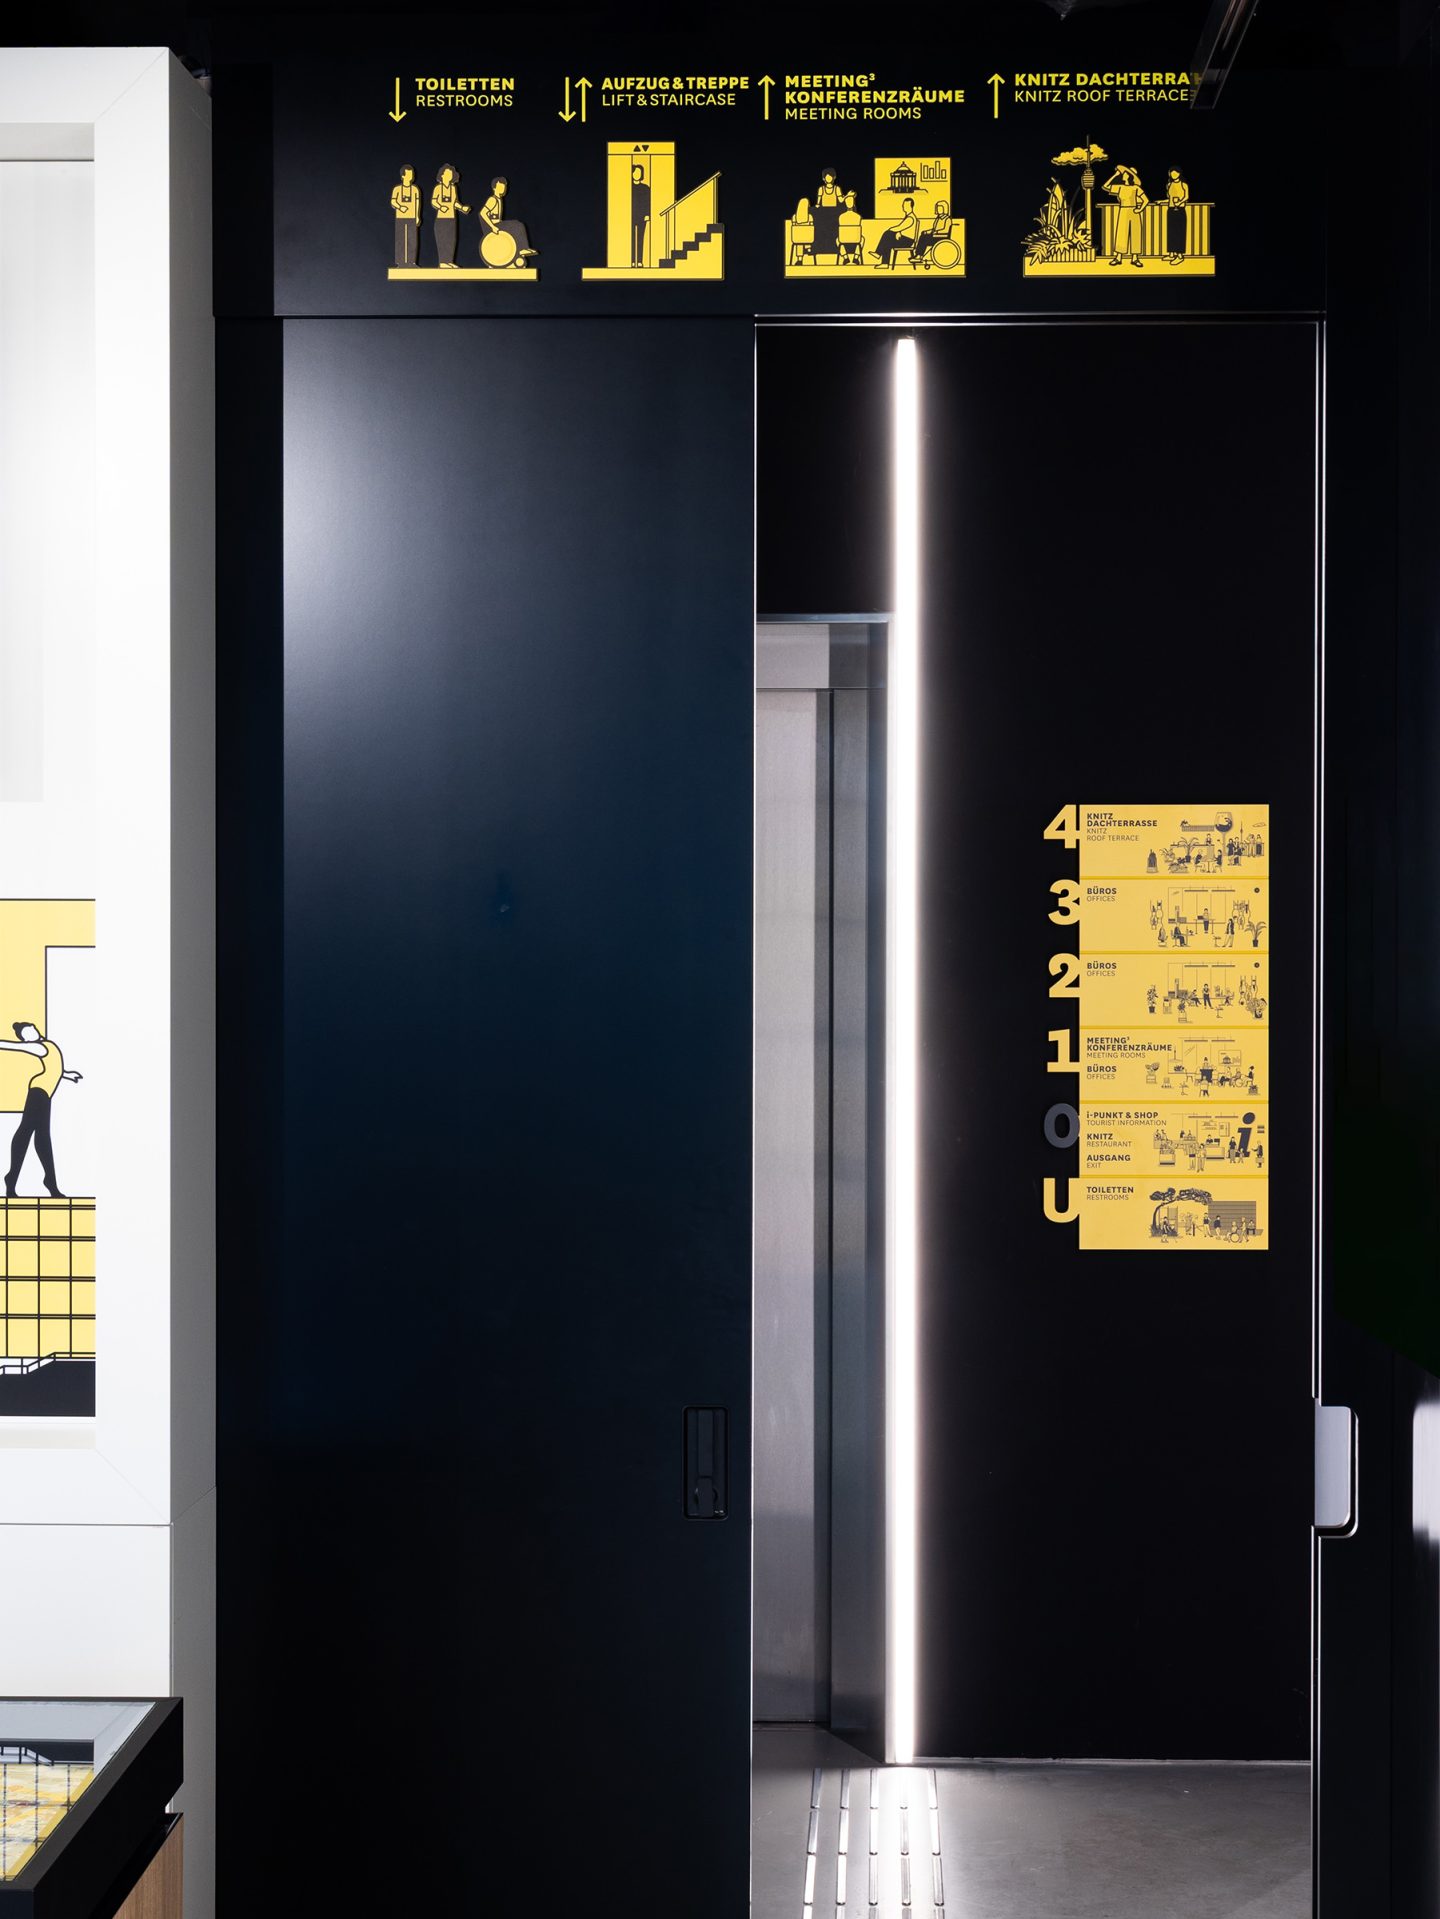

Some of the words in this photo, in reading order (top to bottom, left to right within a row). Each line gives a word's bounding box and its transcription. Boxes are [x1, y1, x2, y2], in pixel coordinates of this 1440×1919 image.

[415, 77, 515, 91] TOILETTEN
[602, 77, 670, 90] AUFZUG
[686, 77, 750, 89] TREPPE
[1014, 74, 1070, 87] KNITZ
[415, 95, 514, 107] RESTROOMS
[602, 94, 635, 106] LIFT
[650, 93, 736, 106] STAIRCASE
[785, 86, 965, 105] KONFERENZRÄUME
[1014, 90, 1062, 103] KNITZ
[1067, 90, 1111, 102] ROOF
[1116, 89, 1189, 102] TERRACE
[785, 107, 858, 120] MEETING
[863, 107, 922, 120] ROOMS
[1086, 812, 1114, 820] KNITZ
[1043, 804, 1080, 849] 4
[1086, 886, 1117, 895] BÜROS
[1048, 879, 1080, 925] 3
[1086, 961, 1117, 970] BÜROS
[1048, 953, 1080, 998] 2
[1047, 1029, 1080, 1073] 1
[1086, 1042, 1173, 1052] KONFERENZRÄUME
[1086, 1064, 1117, 1073] BÜROS
[1086, 1111, 1123, 1119] i-PUNKT
[1125, 1111, 1132, 1119] &
[1134, 1111, 1159, 1119] SHOP
[1086, 1154, 1131, 1162] AUSGANG
[1086, 1186, 1134, 1194] TOILETTEN
[1043, 1178, 1080, 1224] U
